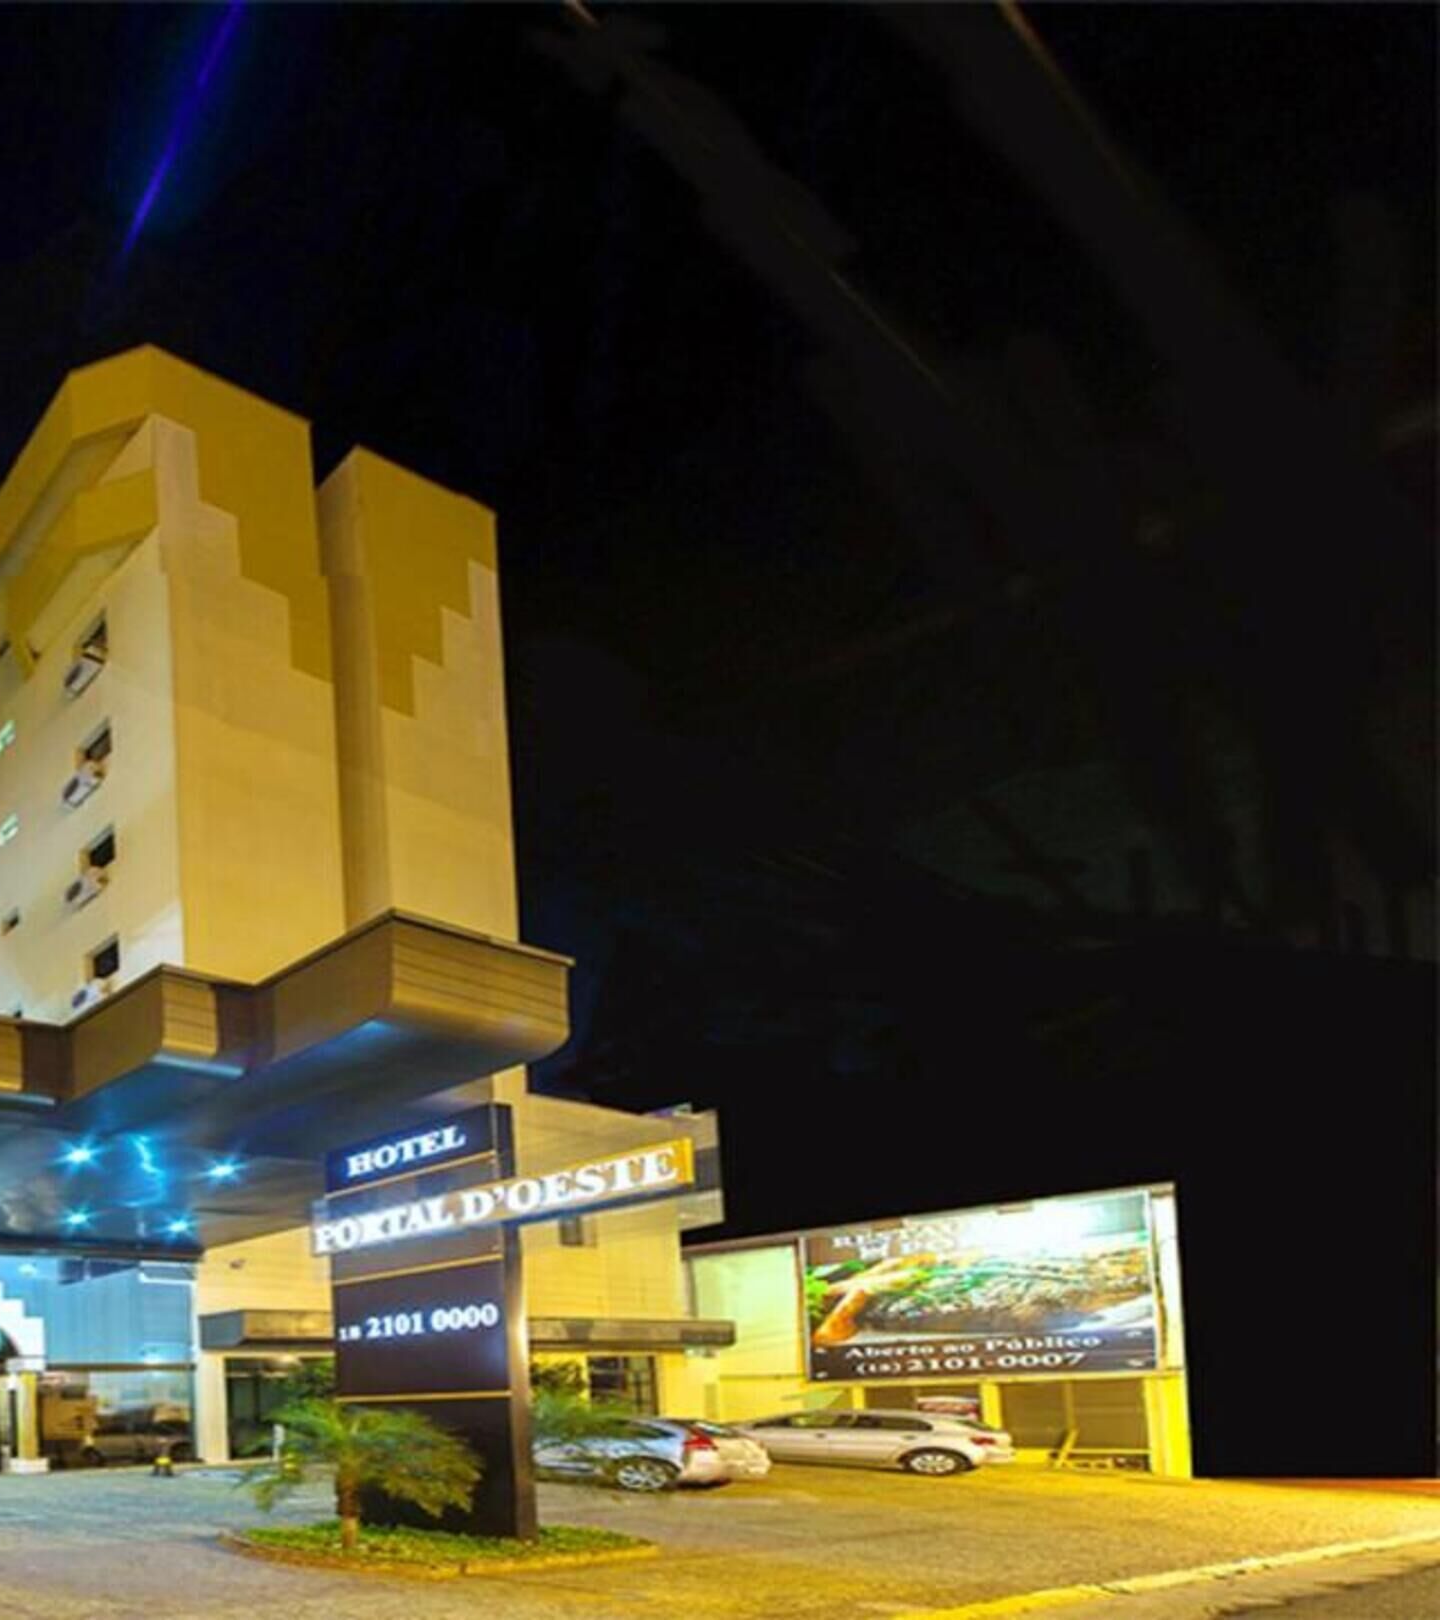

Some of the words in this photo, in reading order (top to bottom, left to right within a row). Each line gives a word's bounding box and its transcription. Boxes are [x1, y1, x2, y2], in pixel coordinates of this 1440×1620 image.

[347, 1125, 466, 1177] HOTEL
[315, 1194, 456, 1252] PORTAL
[366, 1312, 425, 1339] 2101
[431, 1302, 499, 1333] 0000
[844, 1343, 934, 1359] Aberto
[942, 1343, 975, 1354] ao
[984, 1335, 1102, 1352] Público
[906, 1351, 1087, 1371] 2101-0007
